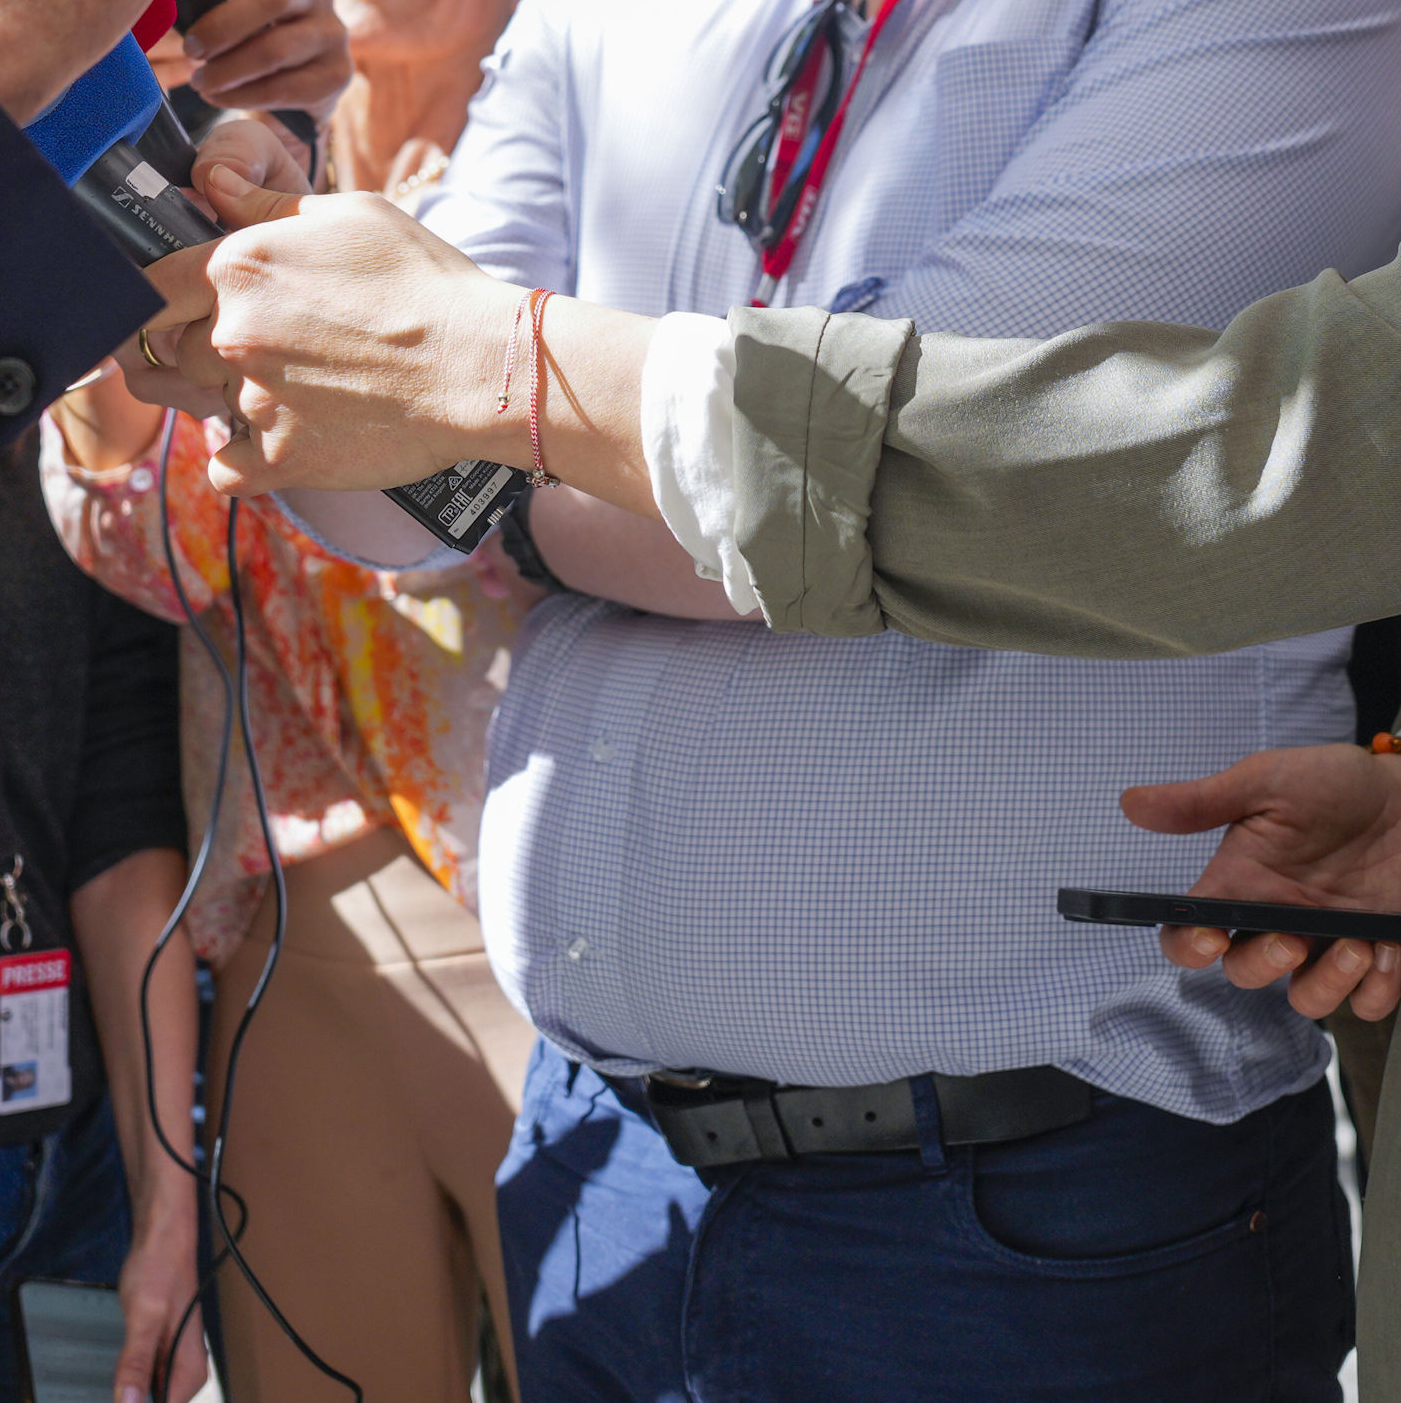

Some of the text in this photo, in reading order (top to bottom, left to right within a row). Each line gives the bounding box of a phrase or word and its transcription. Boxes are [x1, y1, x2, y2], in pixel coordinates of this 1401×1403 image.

[131, 204, 186, 249] SENNHE
[470, 481, 498, 516] 403997
[2, 959, 67, 987] PRESSE
